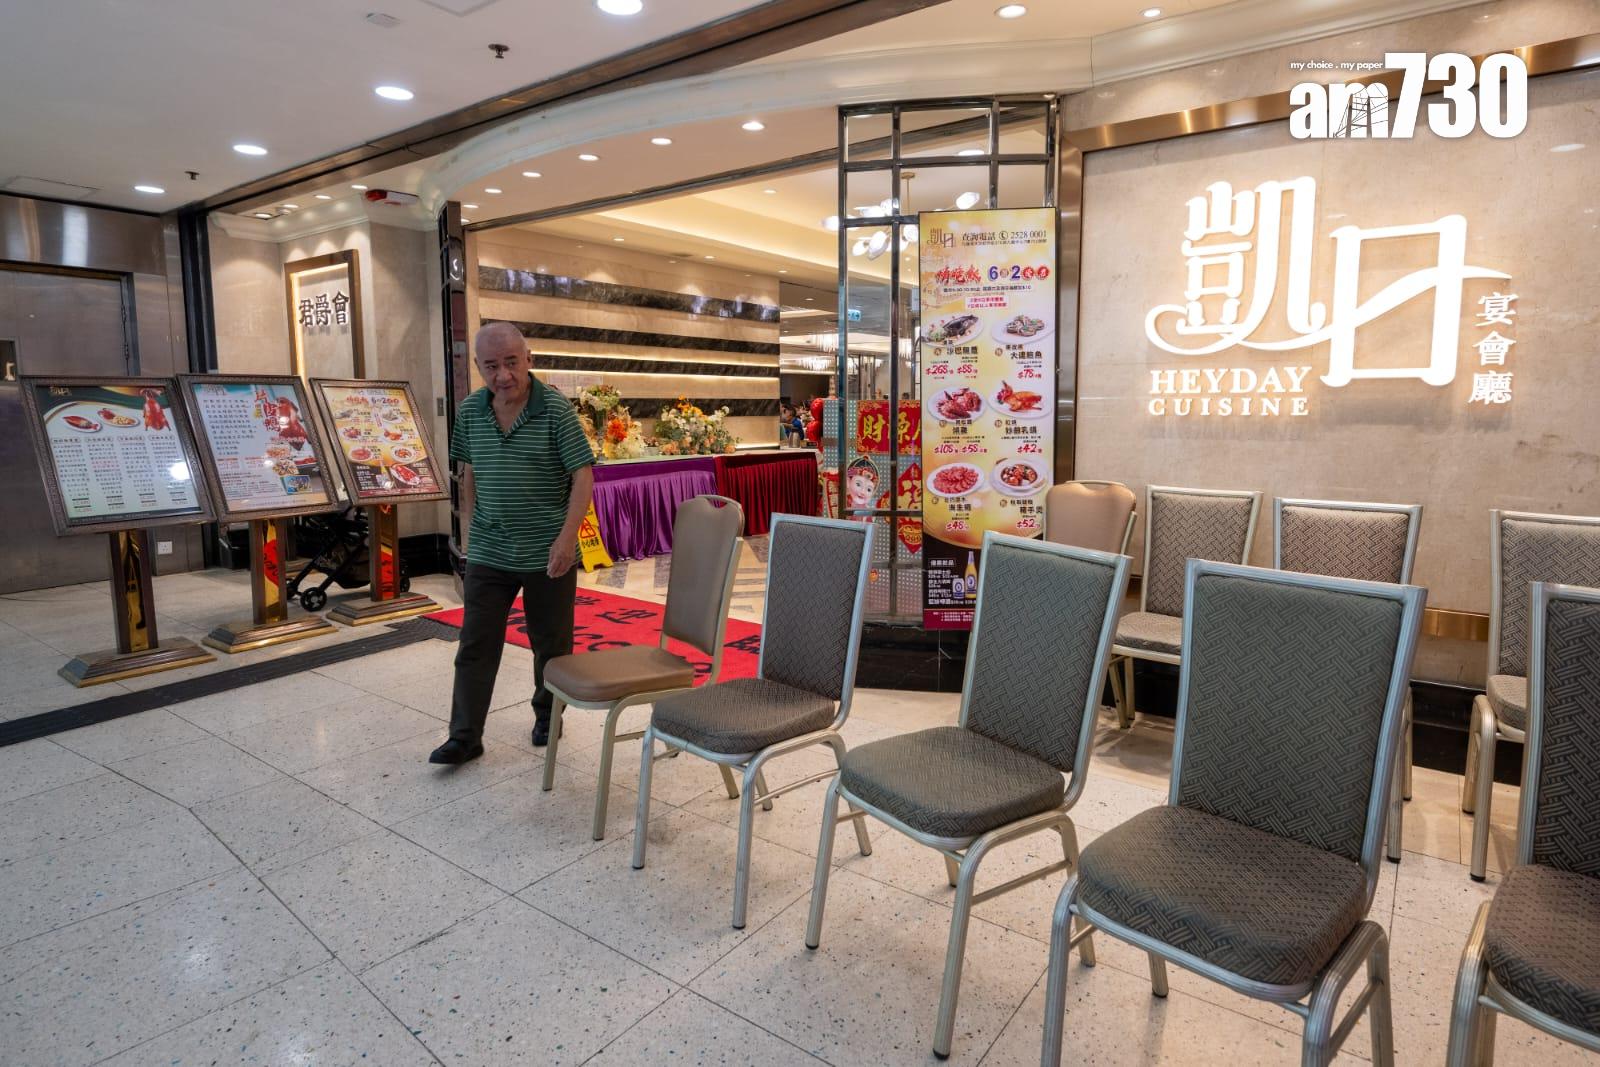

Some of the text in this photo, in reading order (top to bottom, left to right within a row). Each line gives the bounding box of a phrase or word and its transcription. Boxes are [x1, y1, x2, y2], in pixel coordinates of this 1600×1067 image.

[1010, 230, 1028, 239] 2528
[1029, 229, 1047, 239] 0001
[299, 291, 350, 327] 君爵會
[1468, 292, 1520, 405] 宴會廳
[1149, 366, 1313, 395] HEYDAY
[1148, 397, 1310, 417] CUISINE
[863, 411, 921, 441] 財源
[1017, 443, 1037, 454] $42
[1016, 518, 1035, 529] $52
